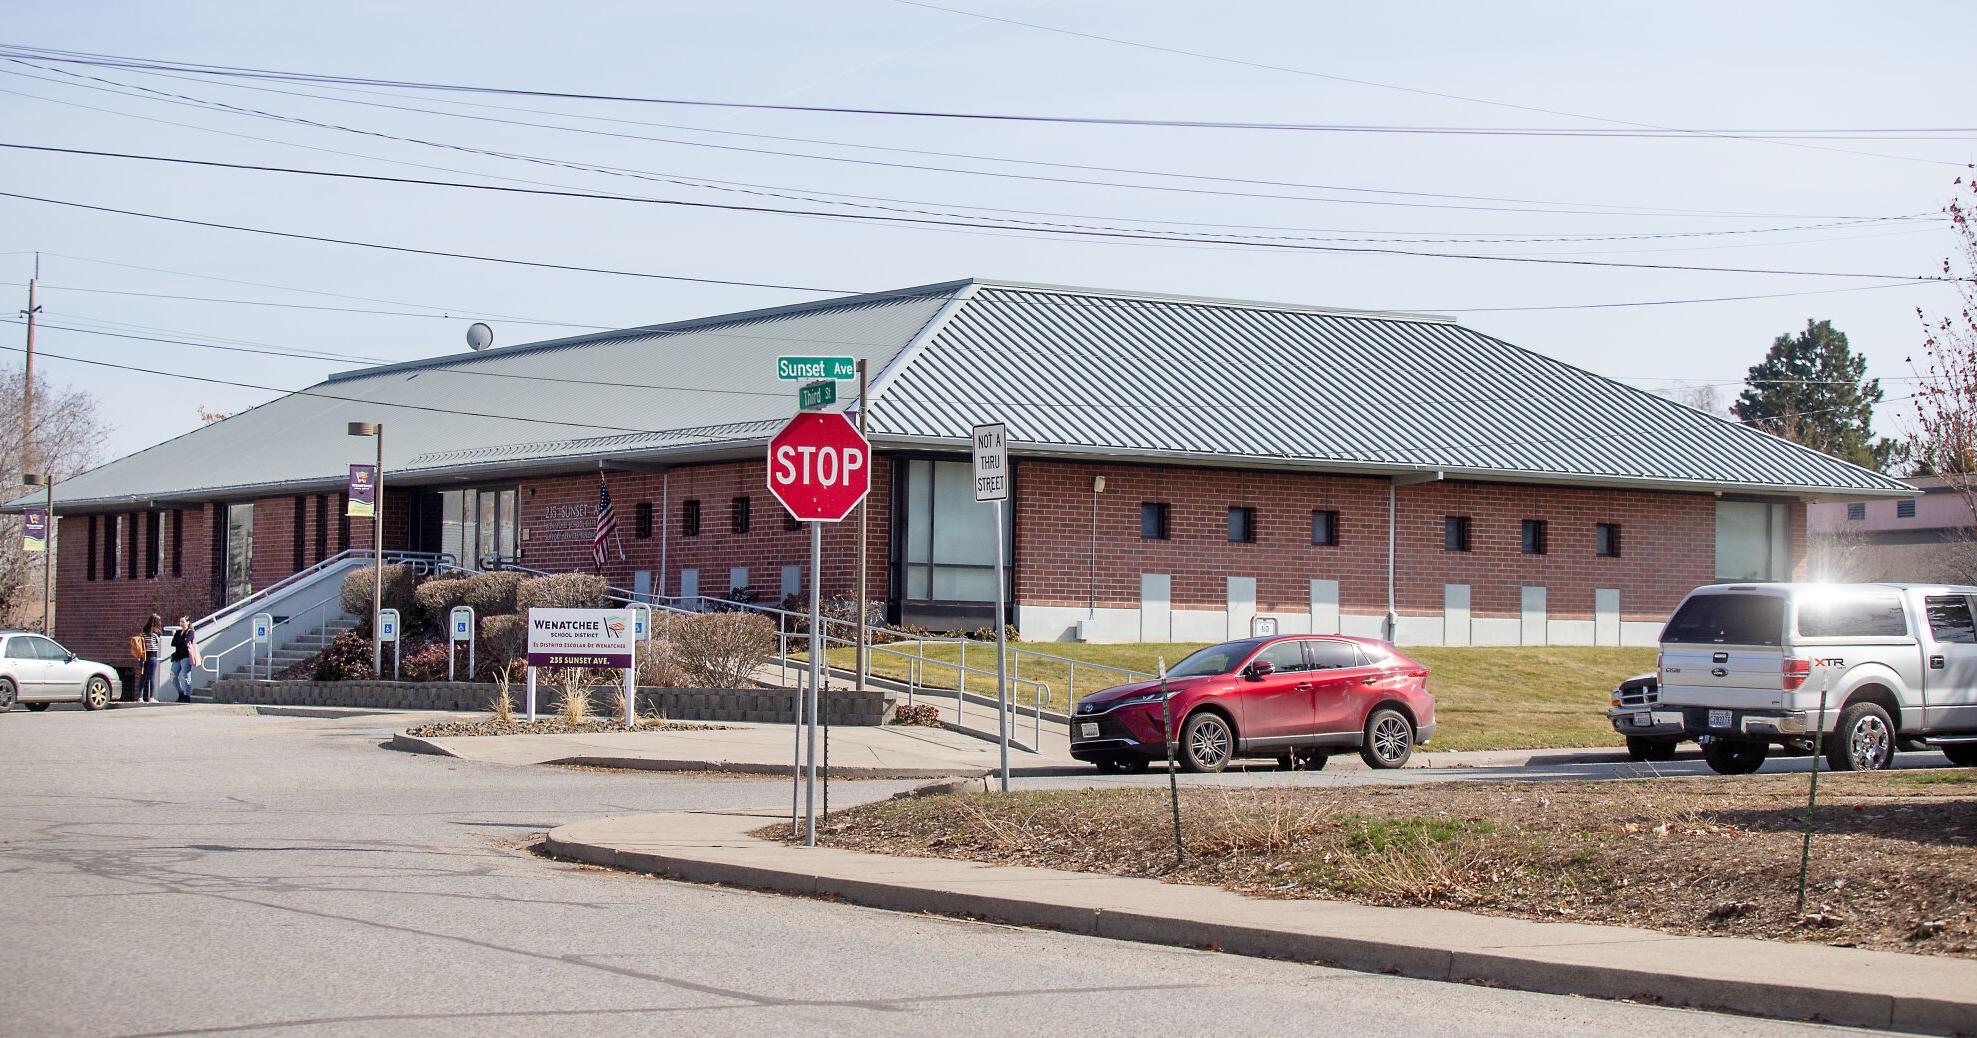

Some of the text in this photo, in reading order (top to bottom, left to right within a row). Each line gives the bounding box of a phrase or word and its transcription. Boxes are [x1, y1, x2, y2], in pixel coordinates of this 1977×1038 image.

[780, 360, 853, 377] Sunset Ave
[803, 387, 832, 406] Third St
[978, 433, 1001, 449] NOT A
[775, 445, 863, 487] STOP
[980, 454, 1000, 470] THRU
[977, 475, 1004, 492] STREET
[561, 503, 588, 518] SUNSET
[534, 619, 599, 630] WENATCHEE
[549, 656, 610, 665] 235 SUNSET AVE.
[1815, 658, 1845, 667] XTR
